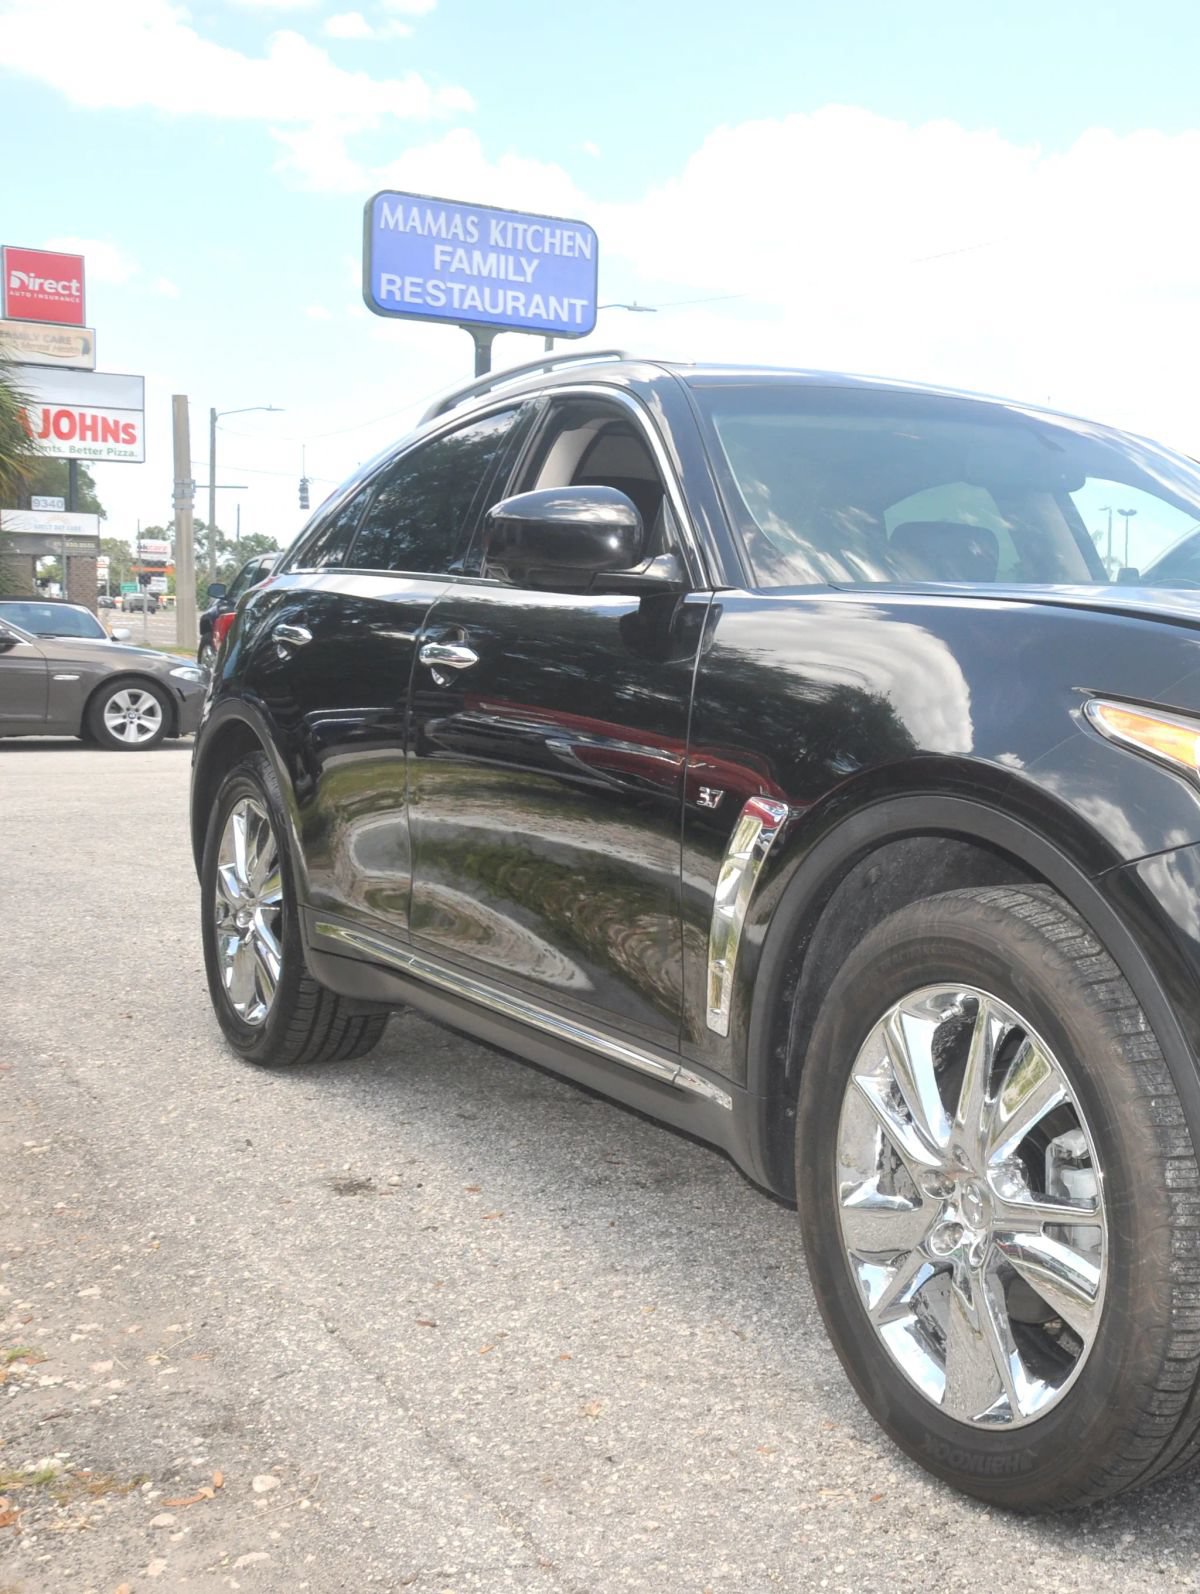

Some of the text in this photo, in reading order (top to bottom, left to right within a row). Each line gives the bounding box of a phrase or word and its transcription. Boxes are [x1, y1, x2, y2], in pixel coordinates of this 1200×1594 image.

[380, 202, 592, 259] MAMAS KITCHEN
[434, 244, 539, 283] FAMILY
[9, 270, 81, 296] Direct
[9, 290, 81, 303] AUTO INSURANCE
[380, 272, 589, 324] RESTAURANT
[37, 407, 137, 445] JOHNS
[69, 445, 103, 455] Better
[107, 447, 138, 457] Pizza.
[33, 498, 63, 509] 9340
